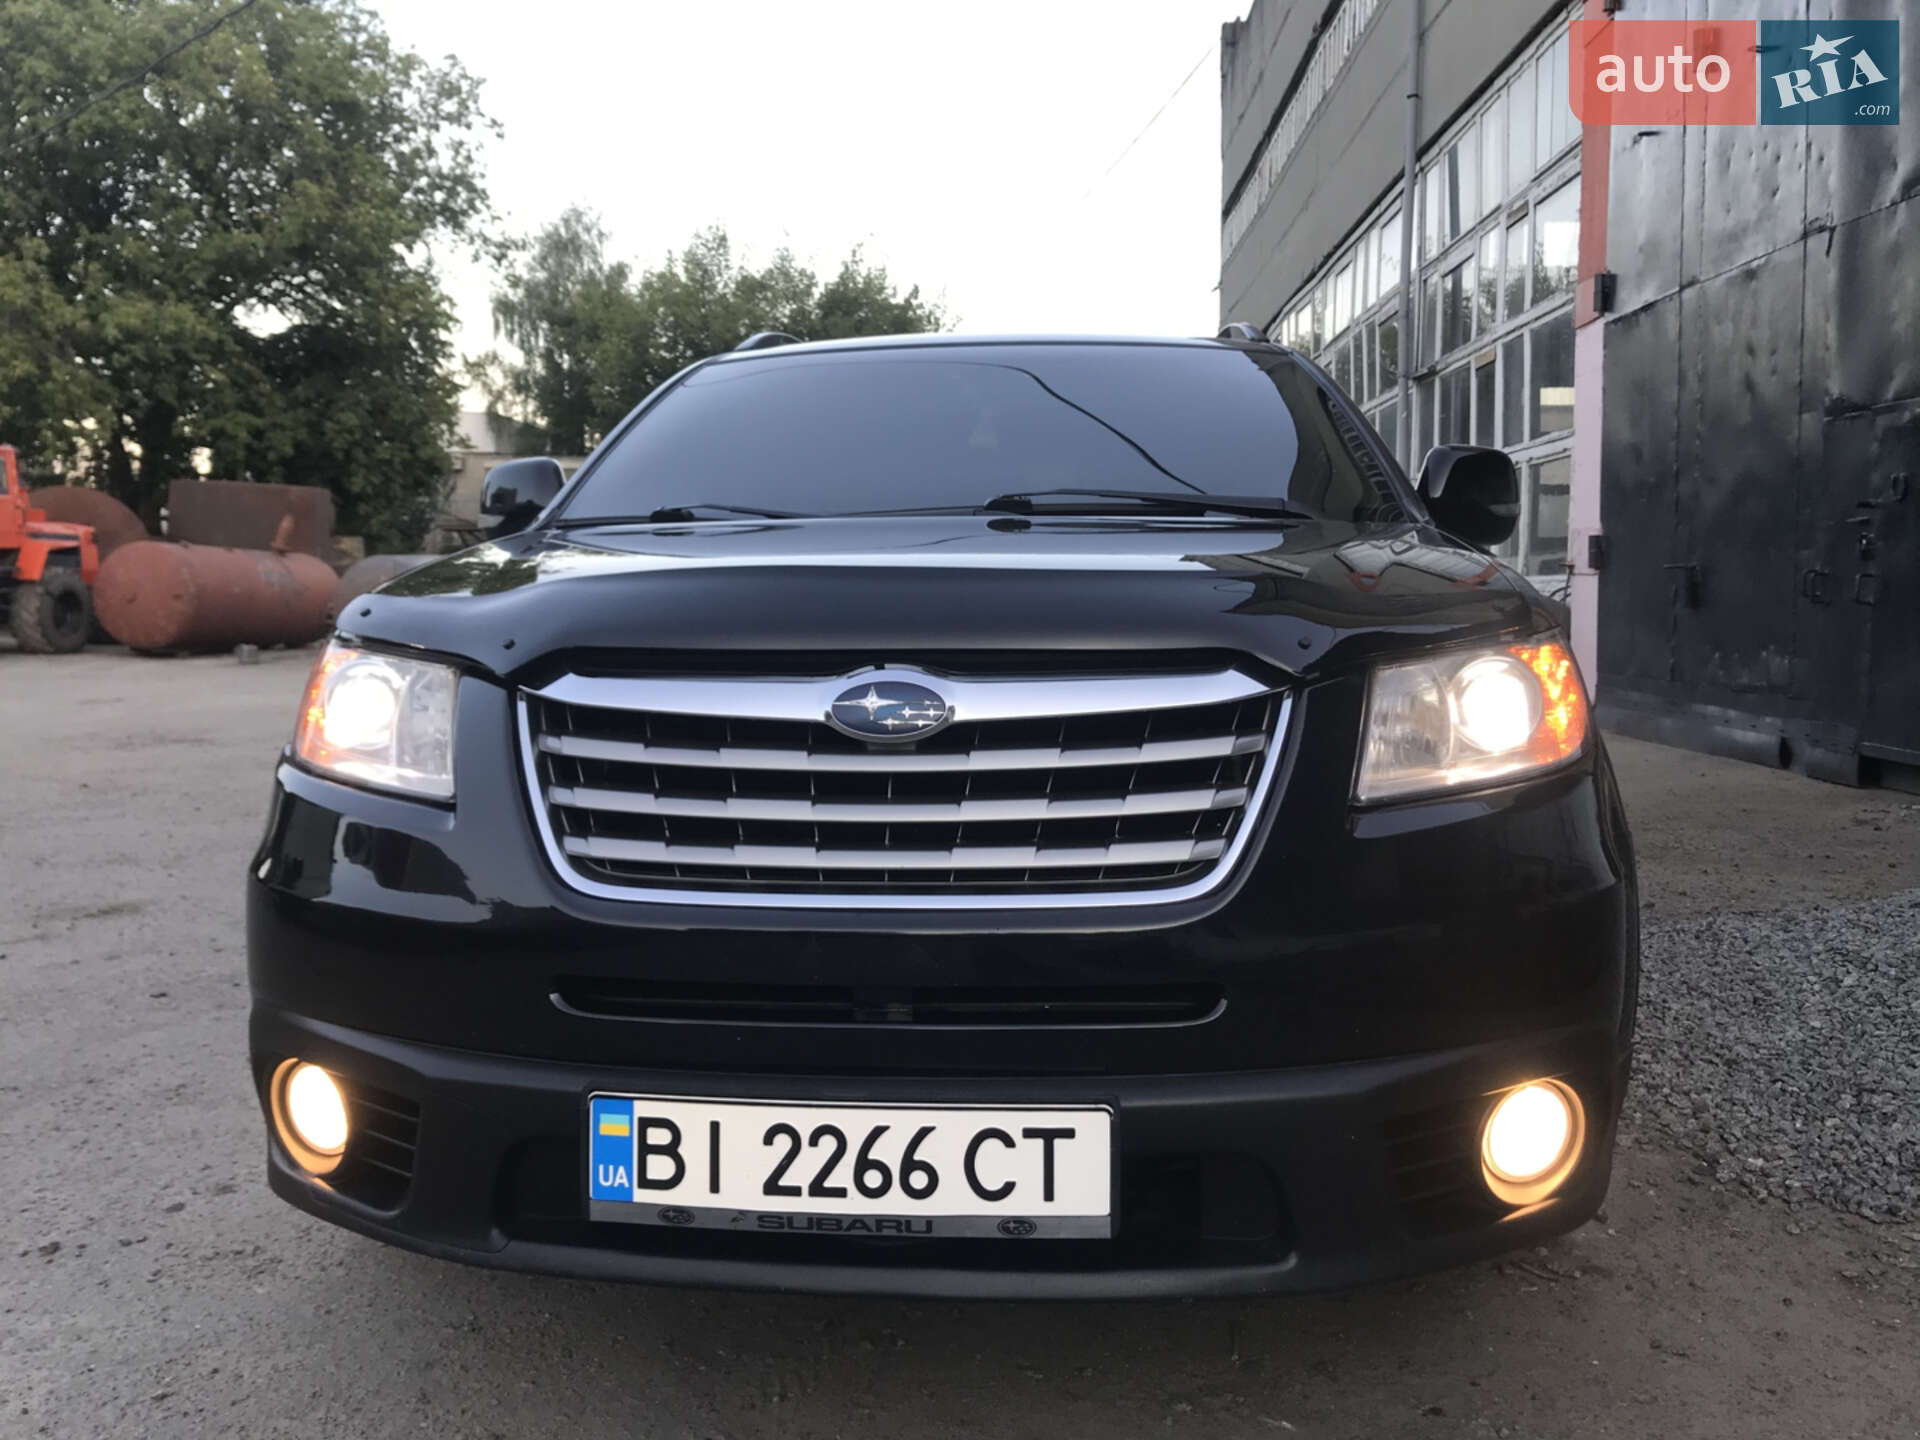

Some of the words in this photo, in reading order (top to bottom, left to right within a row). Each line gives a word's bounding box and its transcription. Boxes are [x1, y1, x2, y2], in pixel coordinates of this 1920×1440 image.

[637, 1116, 720, 1194] BI
[762, 1123, 939, 1200] 2266
[964, 1127, 1076, 1202] CT
[599, 1165, 629, 1188] UA
[757, 1213, 934, 1236] SUBARU
